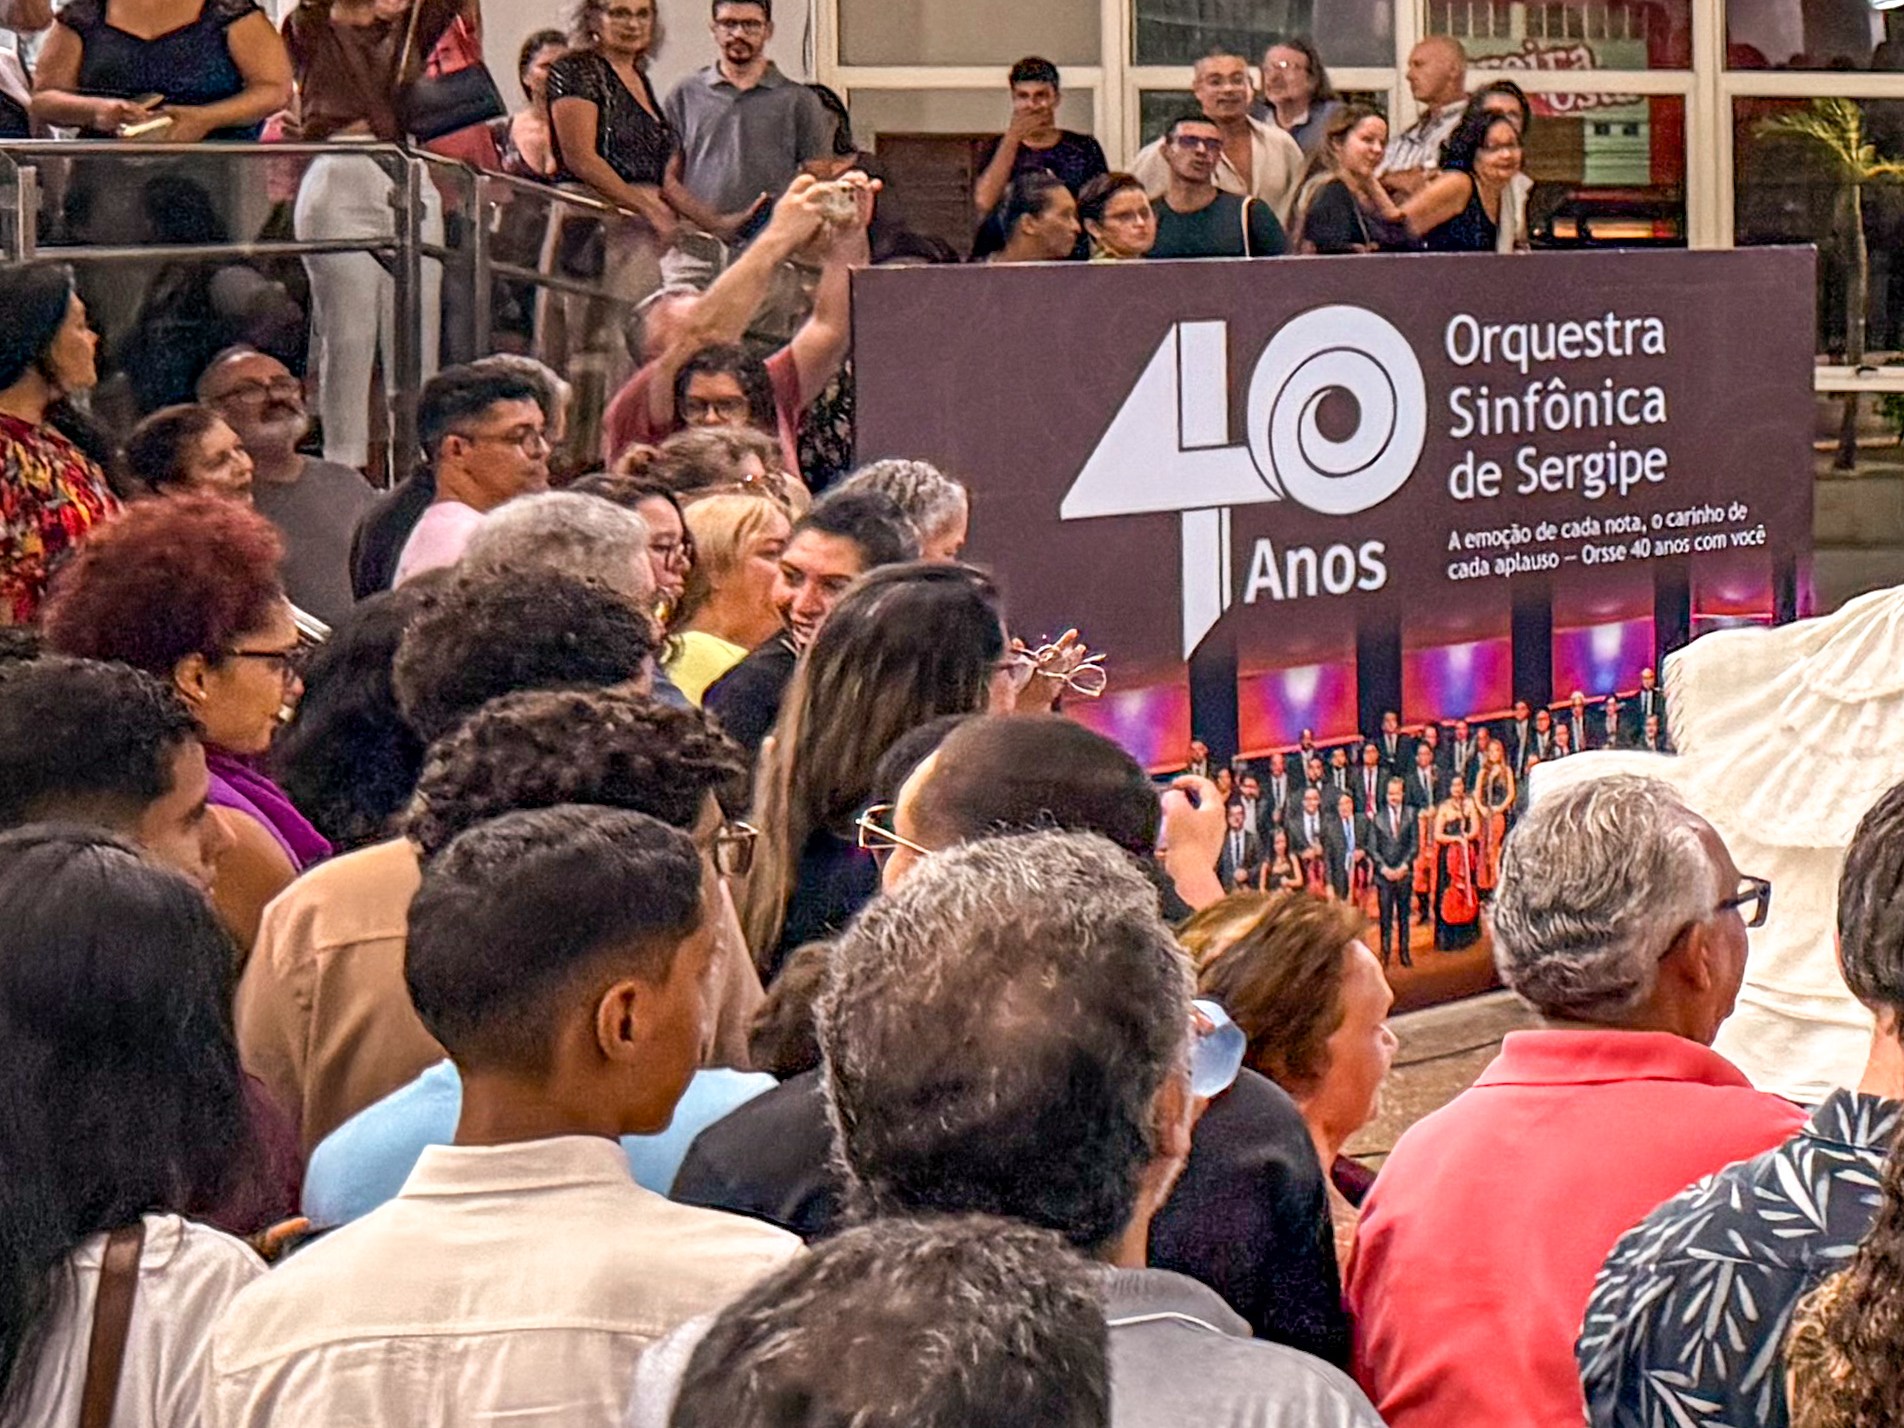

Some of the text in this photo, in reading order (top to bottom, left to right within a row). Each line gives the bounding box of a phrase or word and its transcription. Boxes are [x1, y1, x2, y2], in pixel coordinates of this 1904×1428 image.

[1446, 312, 1666, 374] Orquestra
[1449, 377, 1667, 438] Sinfônica
[1060, 305, 1427, 662] 40
[1449, 440, 1668, 500] de Sergipe
[1447, 556, 1490, 581] cada
[1494, 552, 1560, 577] aplauso
[1582, 543, 1627, 564] Orsse
[1630, 538, 1651, 558] 40
[1654, 537, 1690, 557] anos
[1694, 533, 1727, 552] com
[1731, 524, 1767, 546] você
[1448, 501, 1748, 551] A emoção de cada nota, o carinho de
[1244, 538, 1388, 604] Anos
